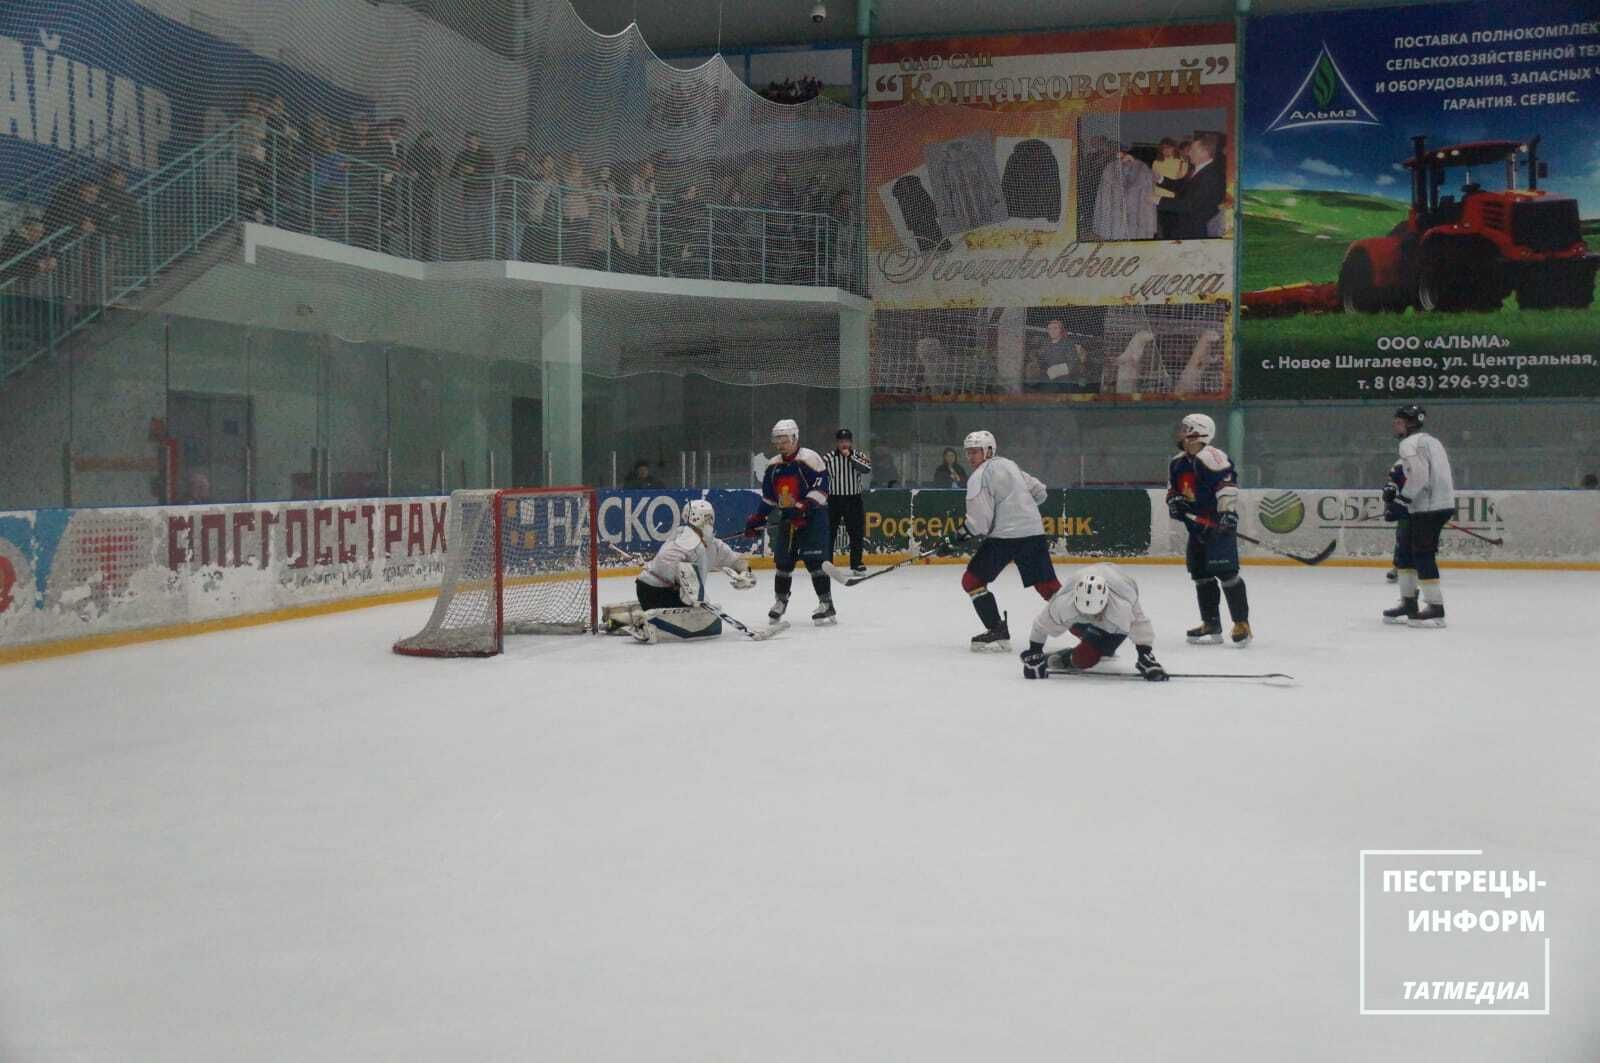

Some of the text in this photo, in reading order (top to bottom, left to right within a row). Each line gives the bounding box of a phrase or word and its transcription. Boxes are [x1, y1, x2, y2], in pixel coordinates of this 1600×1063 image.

[1394, 32, 1468, 49] ПОСТАВКА
[1386, 43, 1575, 71] СЕЛЬСКОХОЗЯЙСТВЕННОЙ
[1375, 82, 1385, 93] И
[1388, 73, 1507, 93] ОБОРУДОВАНИЯ,
[1510, 67, 1591, 85] ЗАПАСНЫХ
[1443, 91, 1580, 111] ГАРАНТИЯ. СЕРВИС.
[1377, 335, 1510, 350] ООО «АЛЬМА»
[1262, 353, 1598, 371] с. Новое Шигалеево, ул. Центральная,
[1357, 374, 1529, 391] т. 8 (843) 296-93-03
[1317, 496, 1503, 522] СБЕНК
